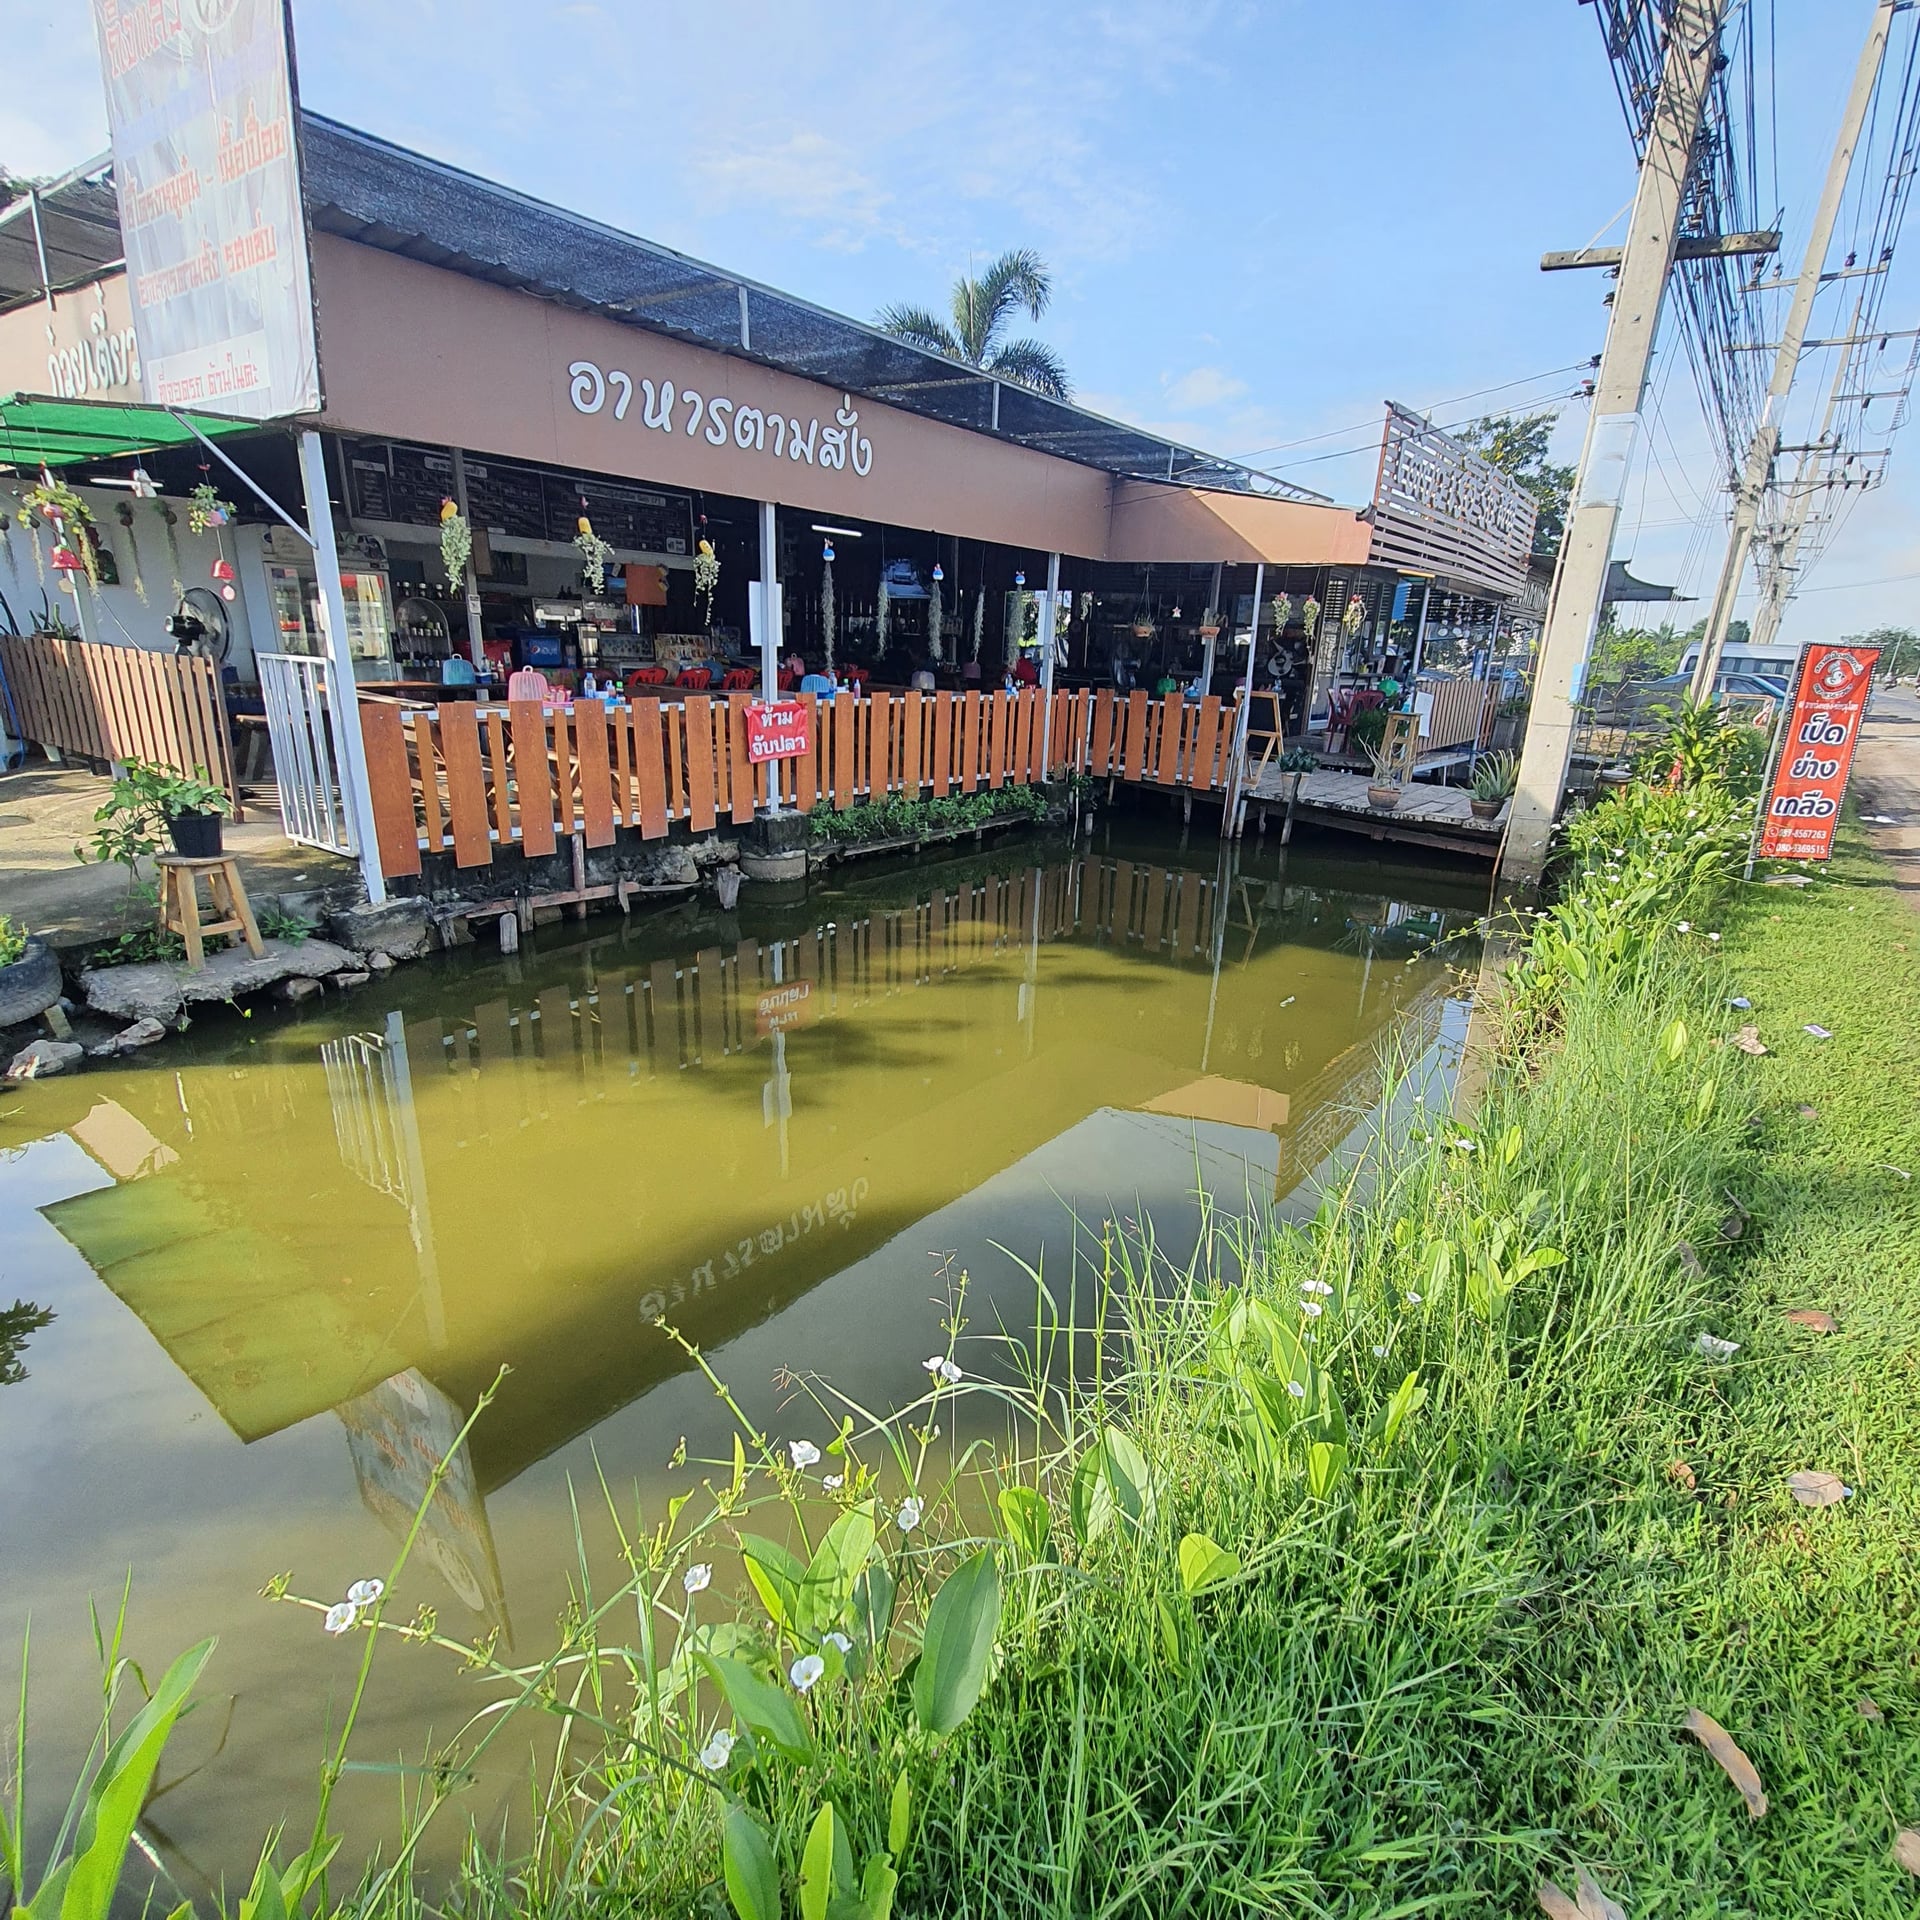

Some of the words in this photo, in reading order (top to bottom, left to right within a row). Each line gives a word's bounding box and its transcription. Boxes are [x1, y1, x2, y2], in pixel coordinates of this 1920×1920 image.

[136, 223, 221, 307] อาหารตามสั่ง
[567, 360, 874, 477] อาหารตามสั่ง
[761, 706, 793, 728] ห้าม
[1799, 713, 1846, 743] เป็ด
[751, 734, 806, 756] จับปลา
[1791, 751, 1837, 778] ย่าง
[1773, 790, 1835, 817] เกลือ
